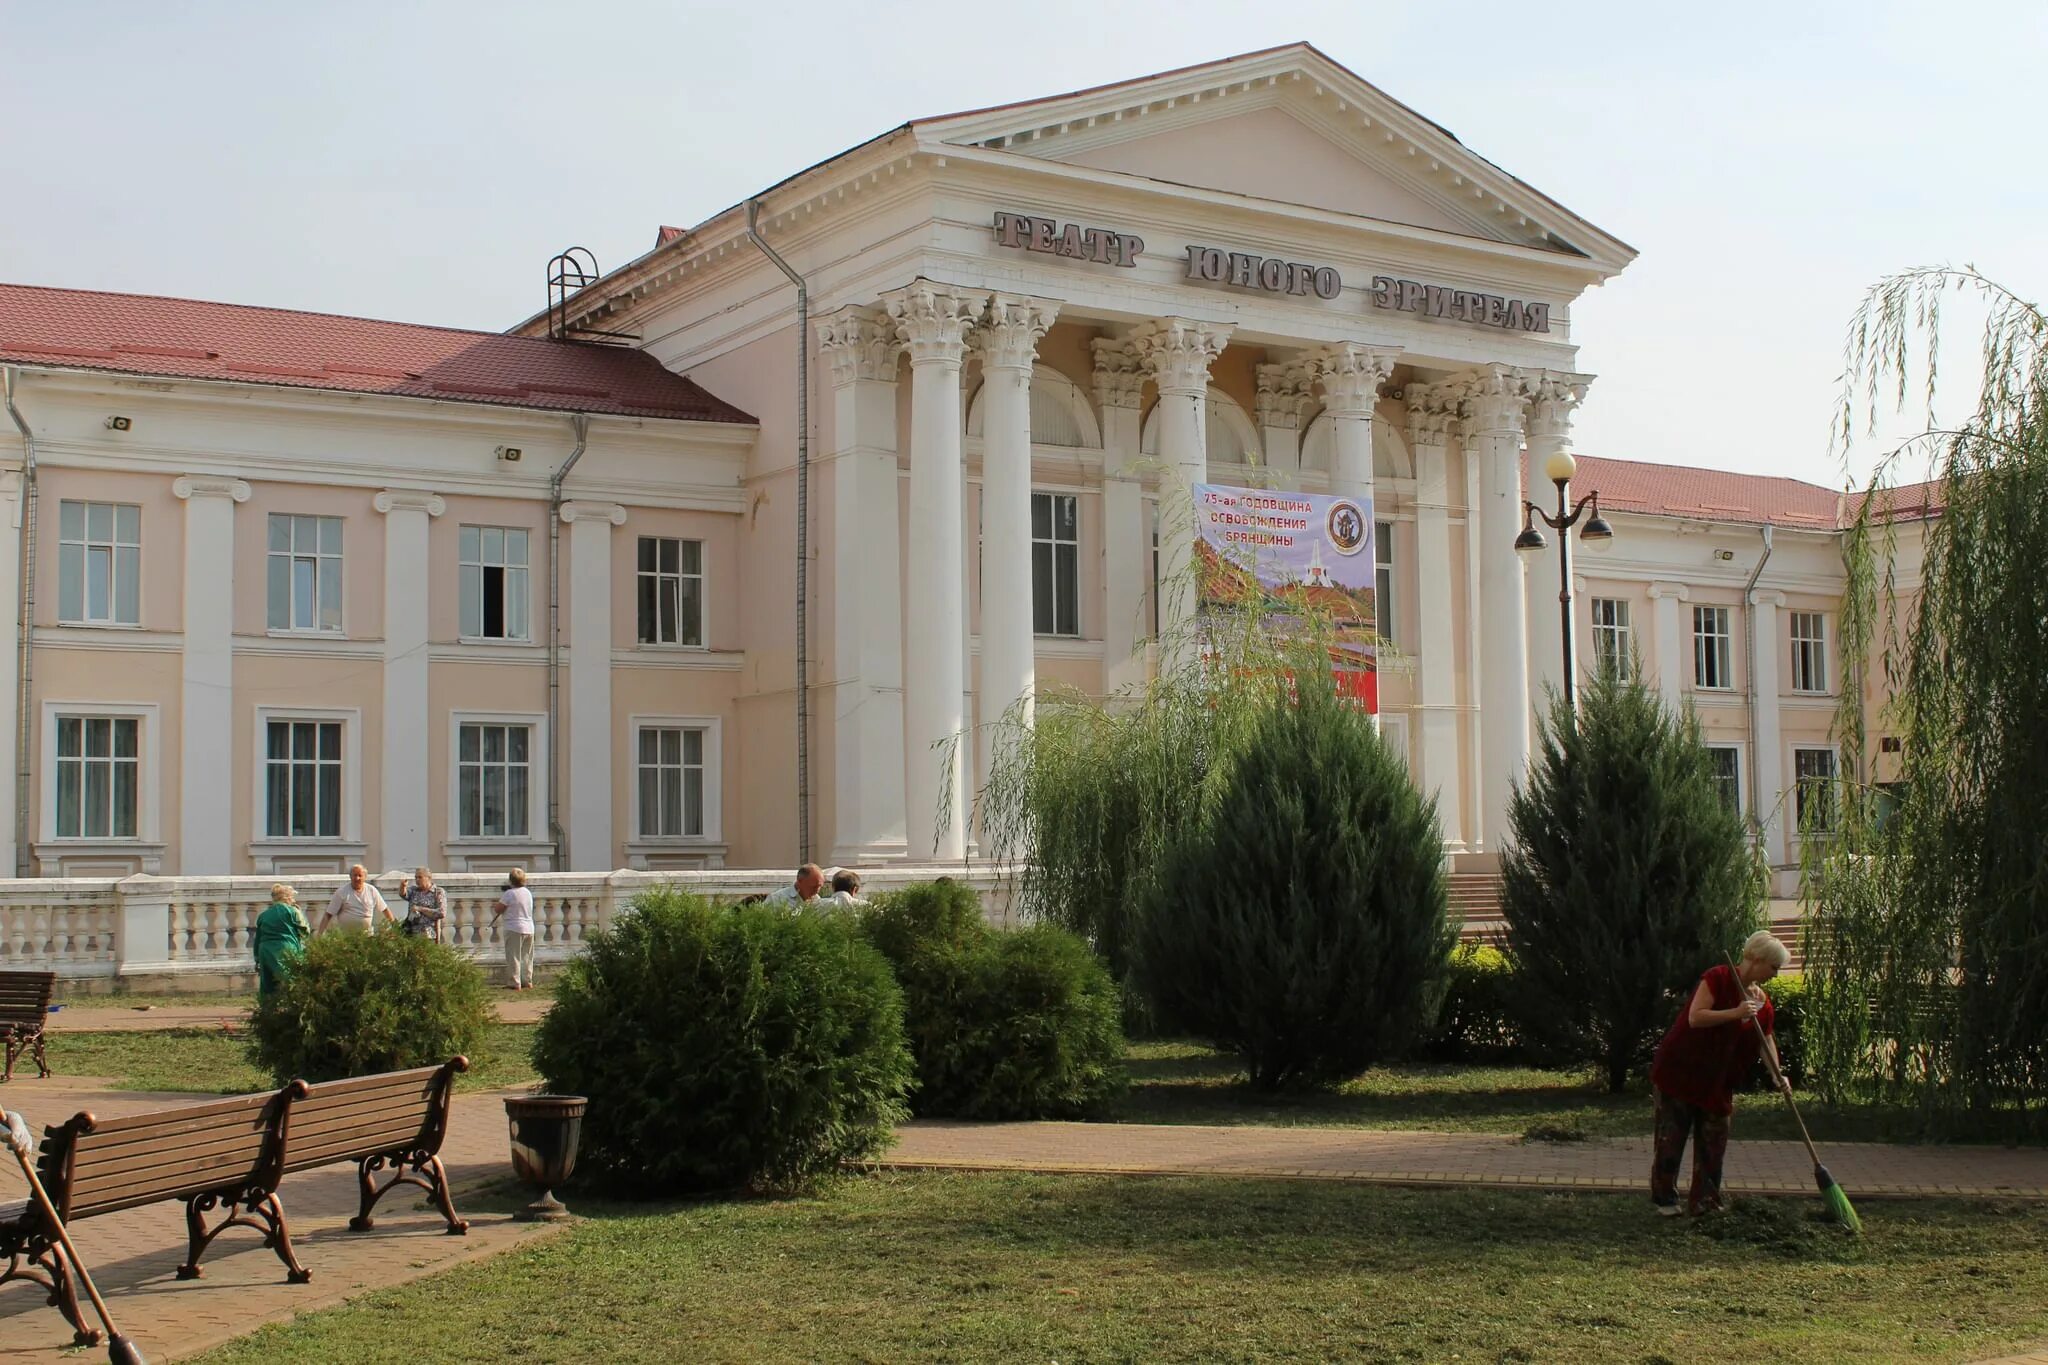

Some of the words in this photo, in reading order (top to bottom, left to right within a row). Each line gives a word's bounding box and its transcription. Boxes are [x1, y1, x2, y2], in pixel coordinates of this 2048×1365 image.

[994, 212, 1145, 268] ТЕАТР
[1185, 245, 1342, 300] ЮНОГО
[1372, 275, 1550, 333] ЗРИТЕЛЯ
[1204, 493, 1237, 506] 75-ая
[1240, 496, 1313, 513] ГОДОВЩИНА
[1210, 512, 1307, 530] ОСВОБОЖДЕНИЯ
[1225, 531, 1293, 547] БРЯНЩИНЫ
